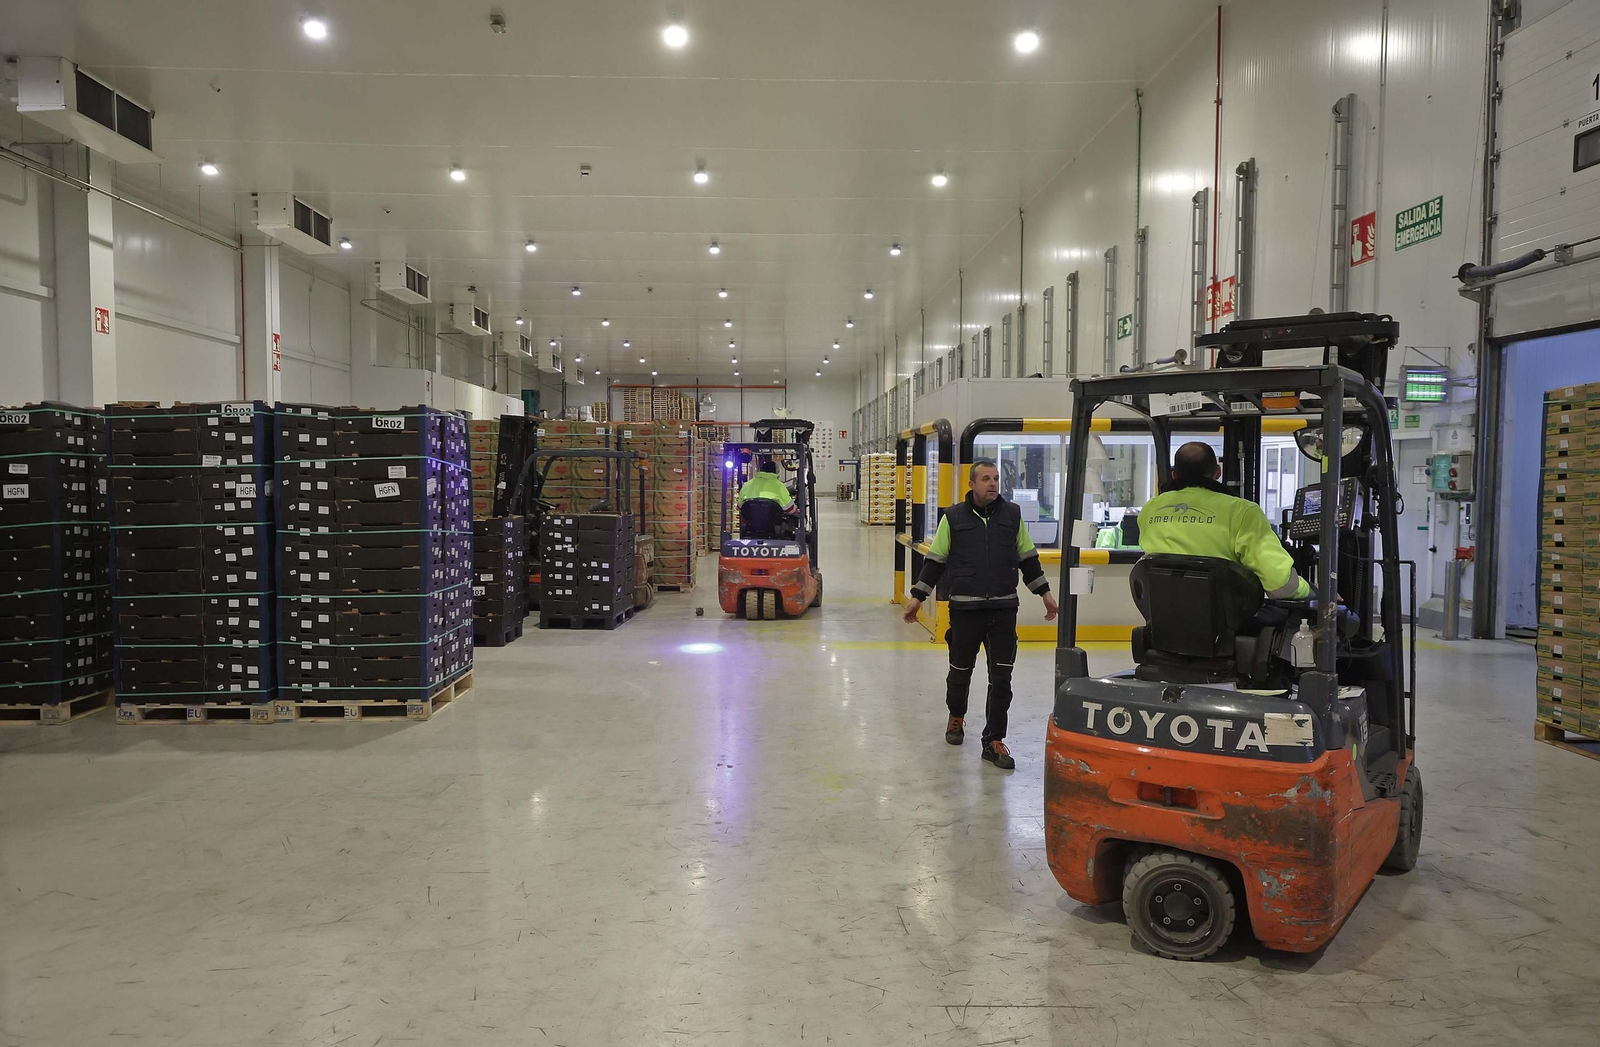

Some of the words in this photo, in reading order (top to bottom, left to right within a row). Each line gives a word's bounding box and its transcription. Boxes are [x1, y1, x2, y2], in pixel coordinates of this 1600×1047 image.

[1578, 113, 1599, 128] PUERTA
[1398, 204, 1427, 229] SALIDA
[1428, 198, 1440, 218] DE
[1396, 217, 1441, 248] EMERGENCIA
[224, 404, 252, 417] 6R02
[375, 416, 402, 429] 6R02
[7, 487, 25, 497] HGFN
[378, 485, 396, 497] HGFN
[732, 546, 789, 557] TOYOTA
[188, 709, 201, 718] EU
[344, 708, 357, 717] EU
[1082, 701, 1269, 753] TOYOTA
